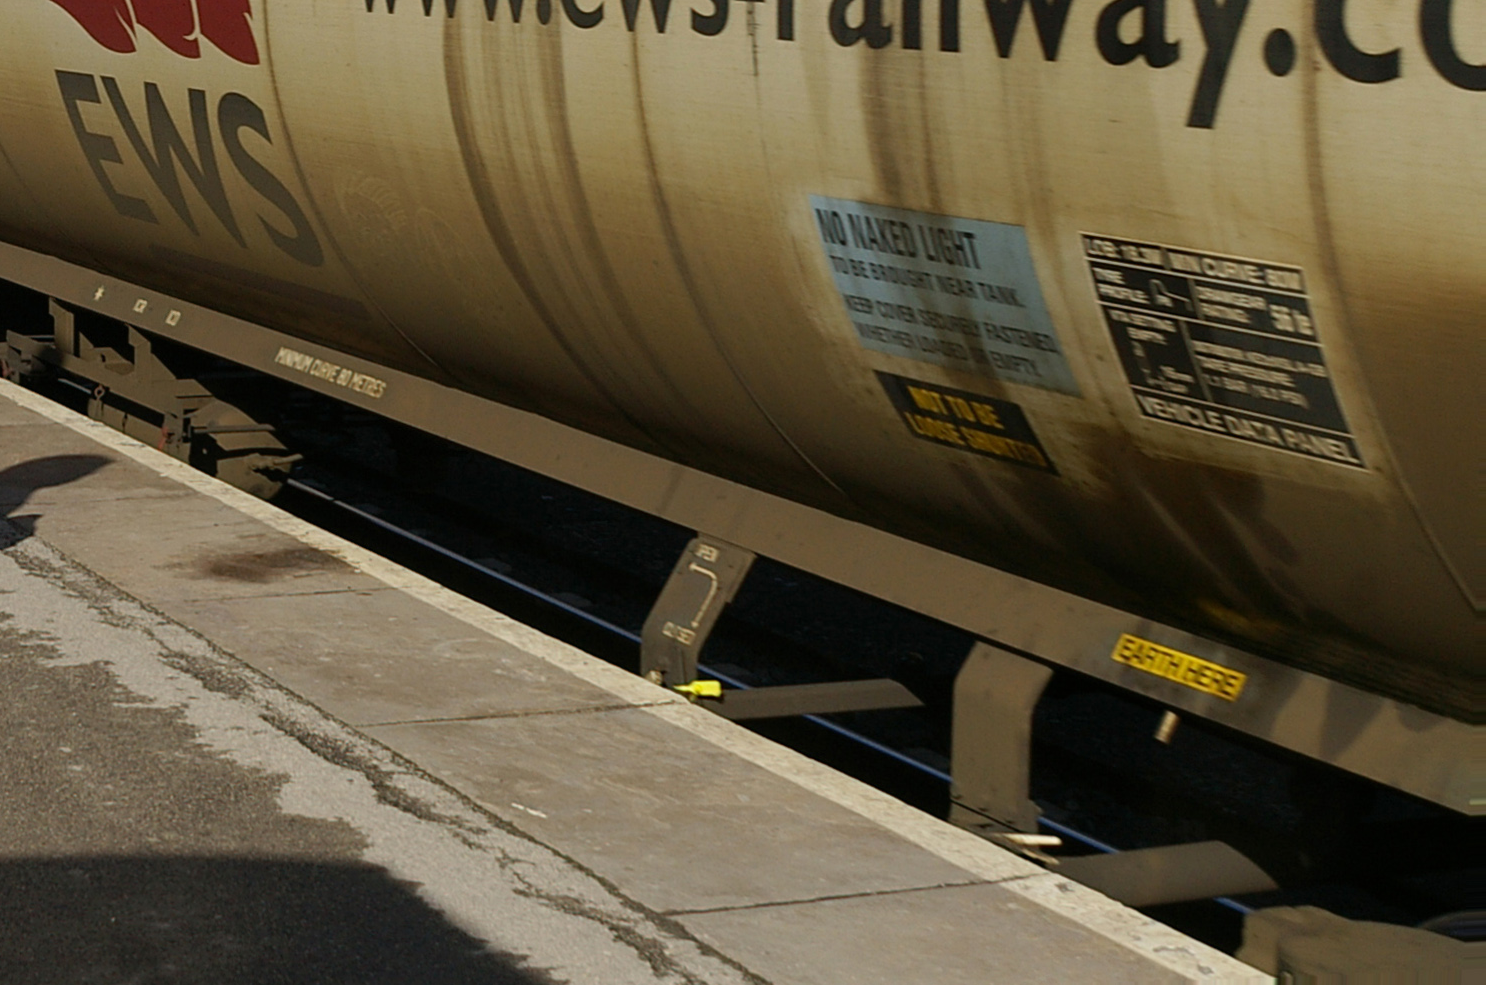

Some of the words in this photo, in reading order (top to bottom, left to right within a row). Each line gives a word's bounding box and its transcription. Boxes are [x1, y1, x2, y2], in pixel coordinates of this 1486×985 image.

[54, 69, 324, 267] EWS
[815, 208, 847, 246] NO
[847, 213, 917, 258] NAKED
[918, 224, 982, 269] LIGHT
[849, 258, 869, 279] BE
[870, 261, 936, 291] BROUGHT
[936, 273, 978, 299] NEAR
[906, 385, 949, 415] NOT
[943, 394, 977, 422] TO
[970, 401, 1005, 430] BE
[1136, 394, 1229, 432] VEHICLE
[1224, 415, 1284, 446] DATA
[1281, 428, 1364, 465] PANEL
[1118, 637, 1180, 678] EARTH
[1182, 656, 1239, 697] HERE
